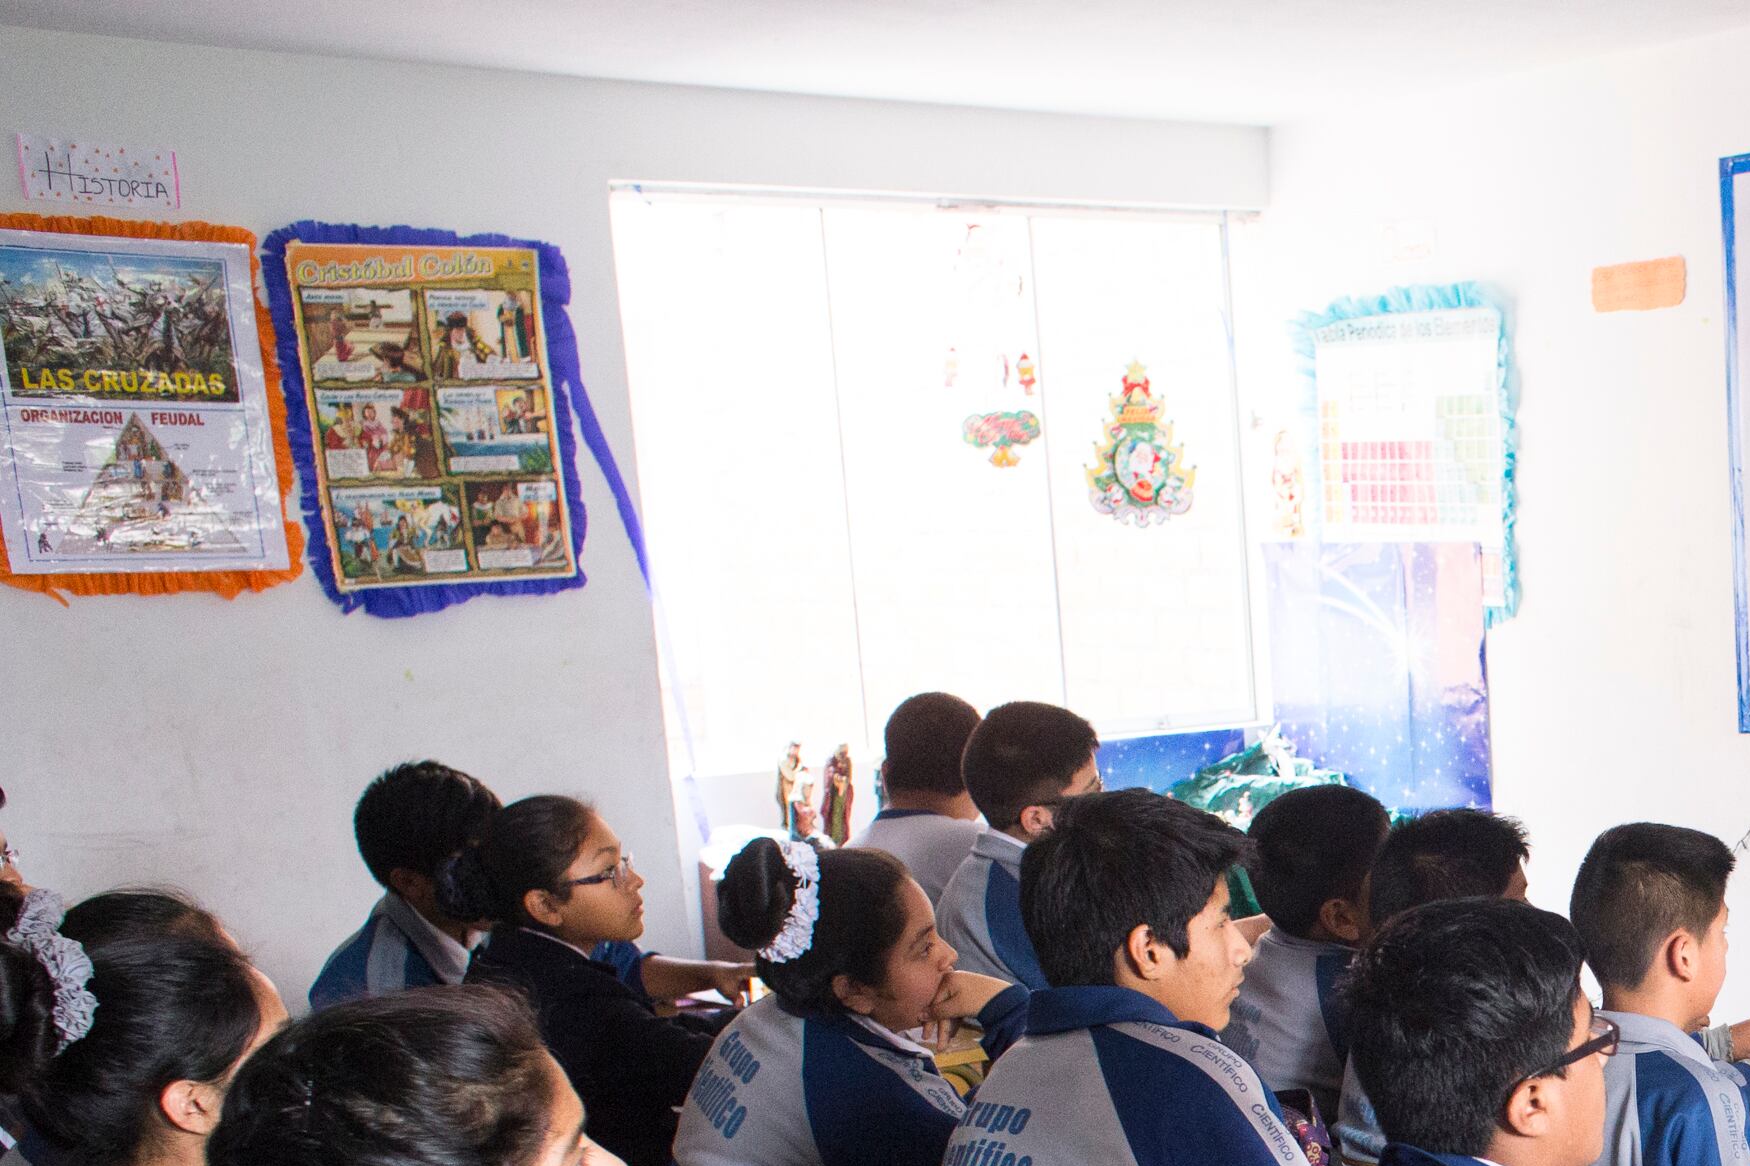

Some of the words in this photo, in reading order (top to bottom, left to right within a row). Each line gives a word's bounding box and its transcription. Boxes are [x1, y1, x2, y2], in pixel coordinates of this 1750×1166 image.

[38, 151, 169, 199] HISTORIA
[419, 251, 493, 278] Colón
[21, 367, 76, 391] LAS
[84, 369, 227, 395] CRUZADAS
[20, 409, 123, 425] ORGANIZACION
[151, 411, 205, 426] FEUDAL
[719, 1031, 760, 1085] Grupo
[1251, 1103, 1294, 1161] CIENTÍFICO
